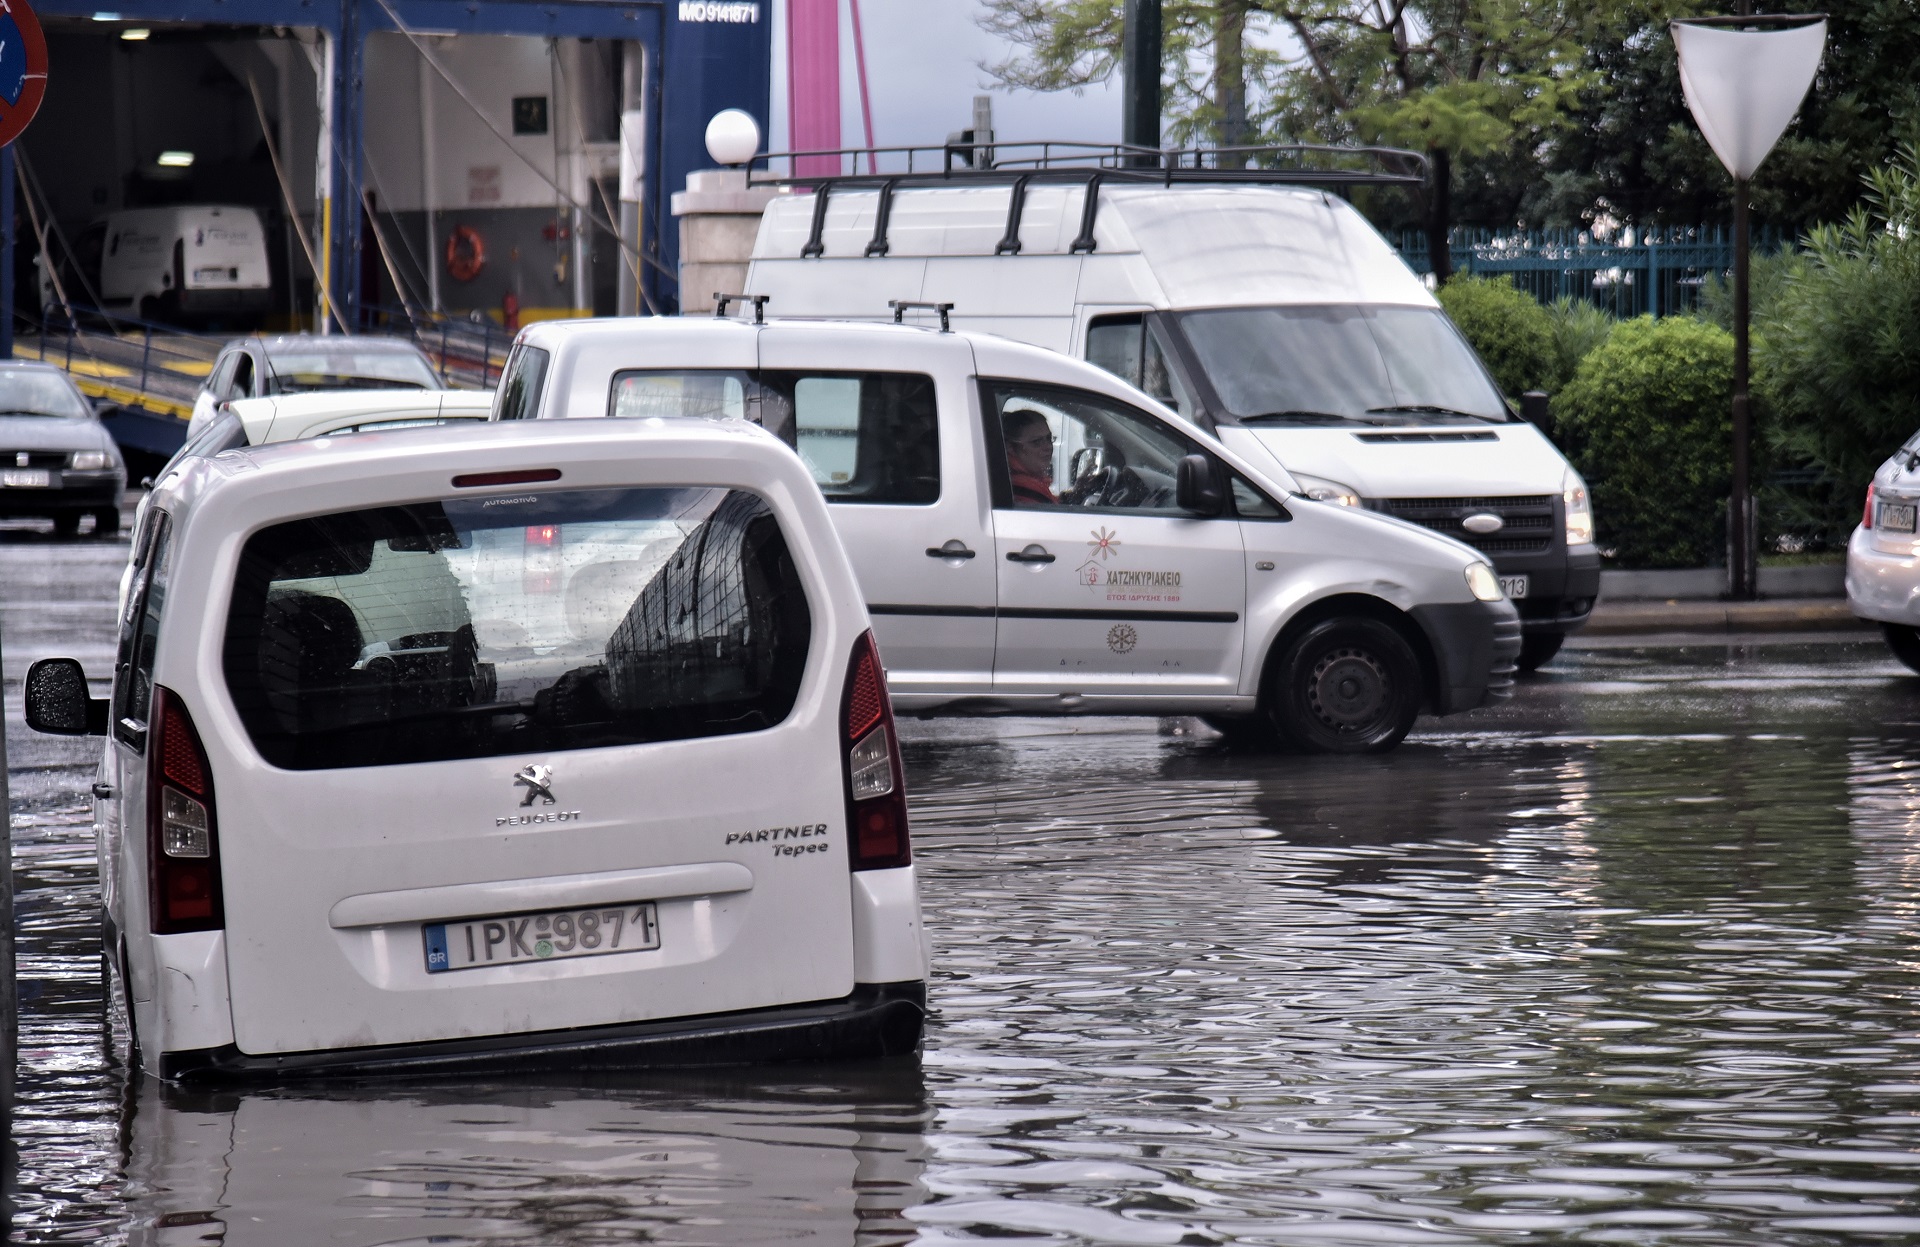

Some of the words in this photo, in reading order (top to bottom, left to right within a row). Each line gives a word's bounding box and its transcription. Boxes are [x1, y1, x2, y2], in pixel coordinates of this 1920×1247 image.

[678, 1, 706, 21] IMO
[482, 495, 537, 508] AUTOMOTIVO
[1106, 570, 1181, 586] ΧΑΤΖΗΚΥΡΙΑΚΕΙΟ
[1128, 594, 1161, 602] ΙΔΡΥΣΗΣ
[495, 809, 581, 827] PEUGEOT
[725, 823, 828, 846] PARTNER
[771, 842, 829, 858] Tepee
[428, 952, 446, 964] GR
